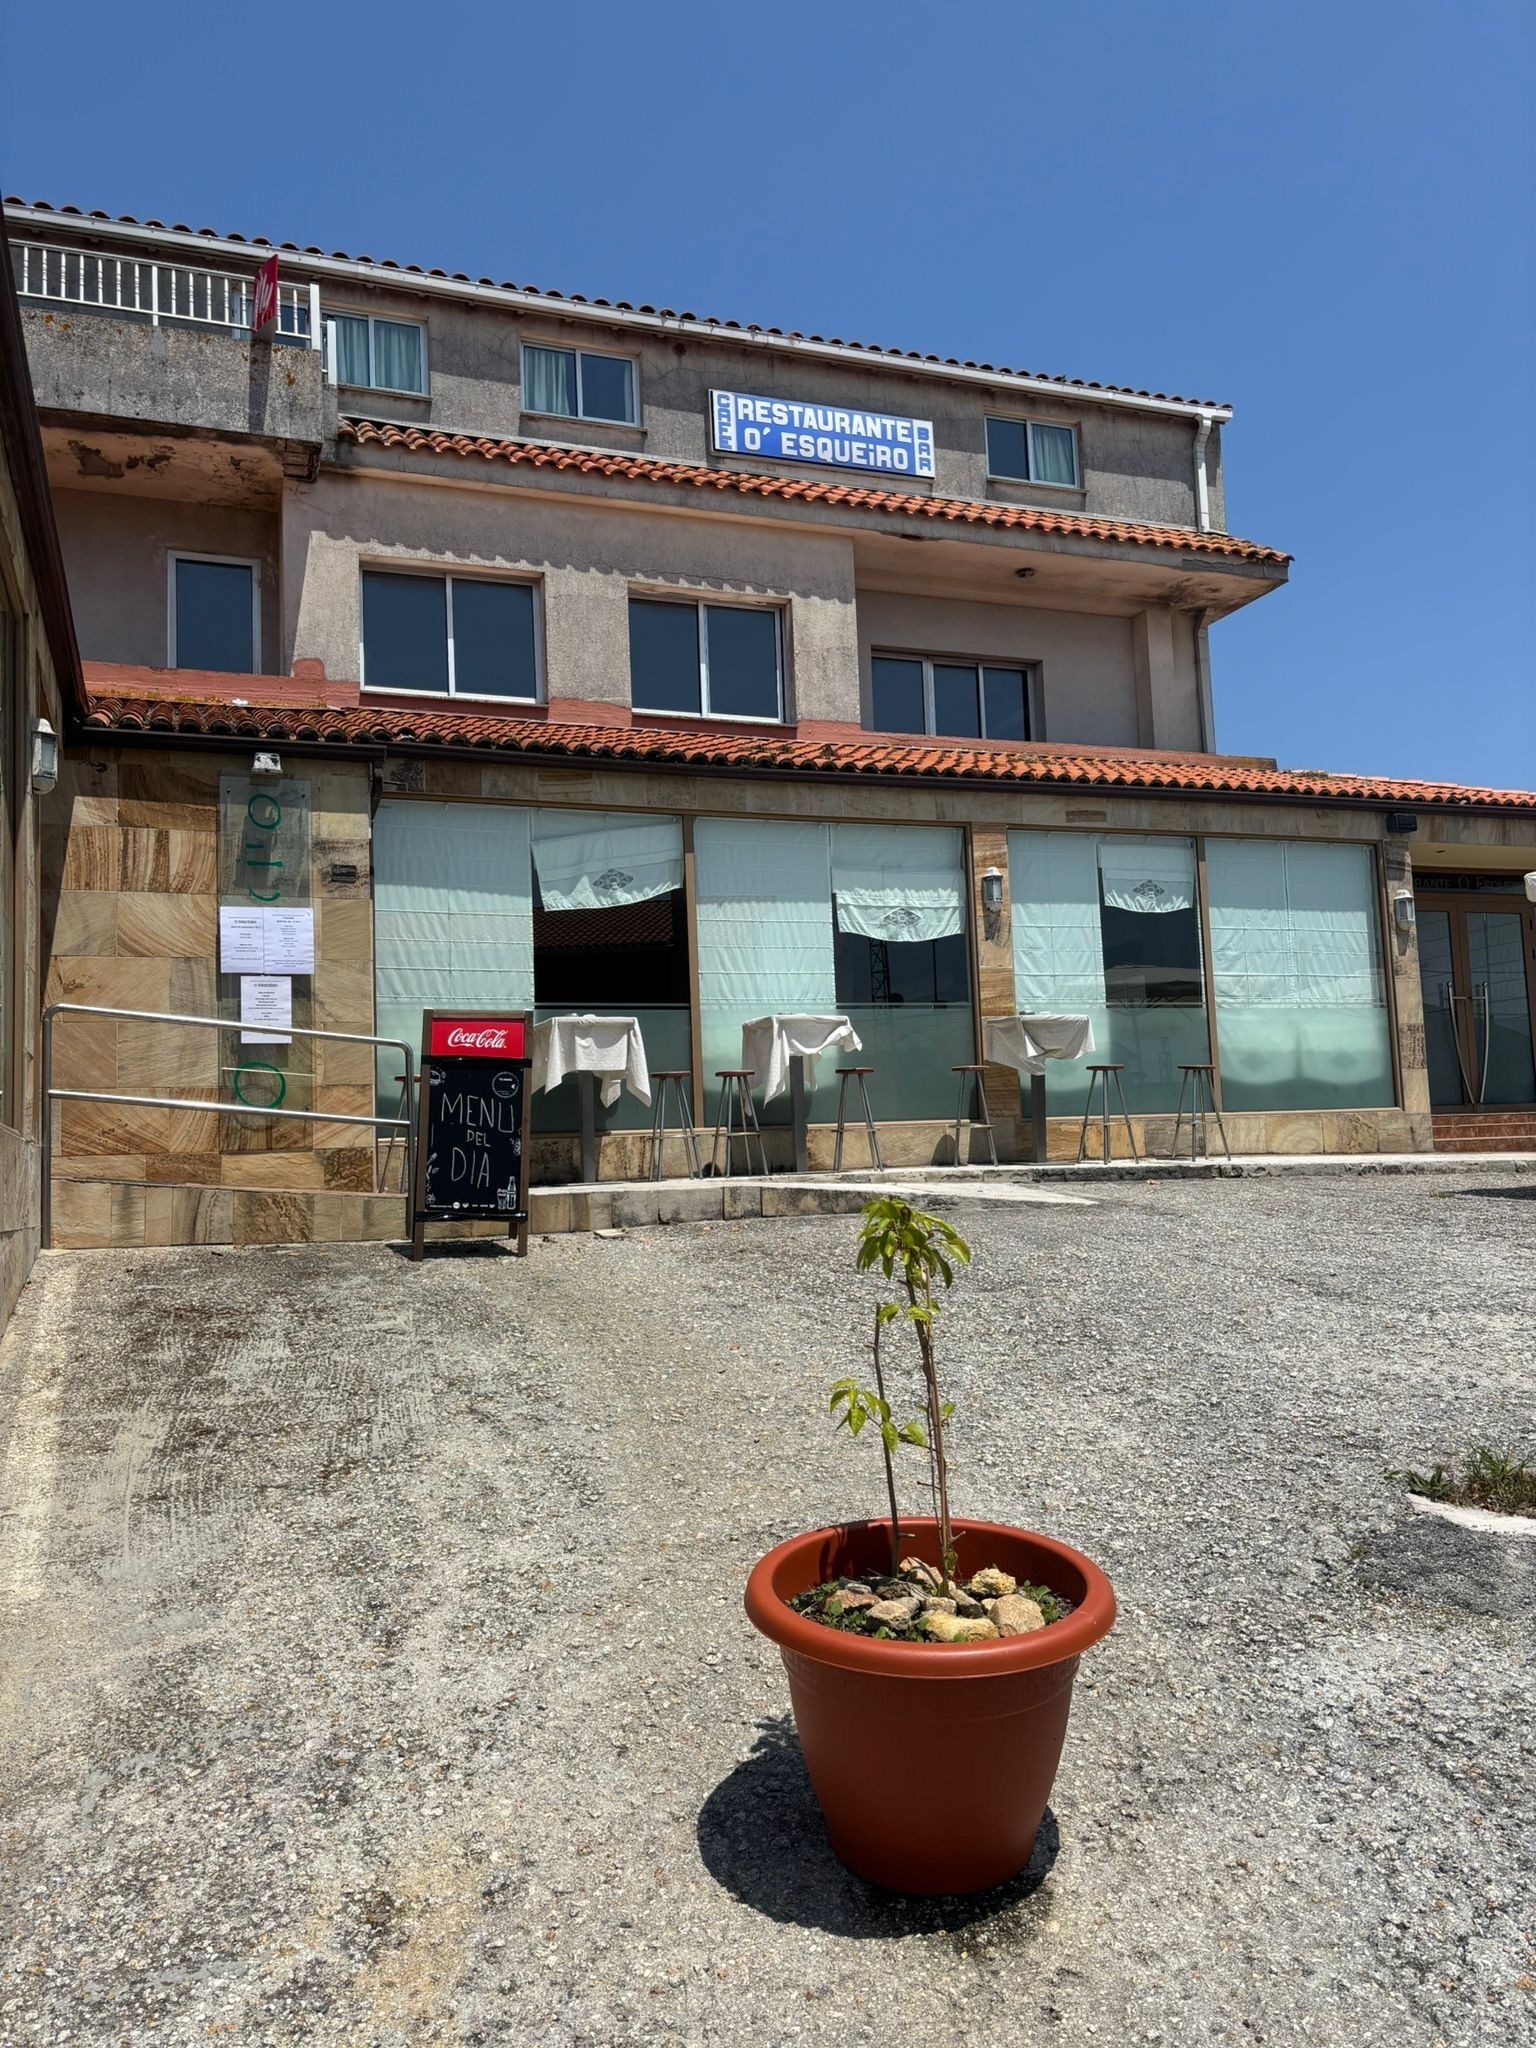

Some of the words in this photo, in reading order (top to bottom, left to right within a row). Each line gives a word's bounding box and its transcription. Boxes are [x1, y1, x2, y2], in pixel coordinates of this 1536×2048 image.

[717, 393, 733, 450] CAFE
[738, 398, 912, 444] RESTAURANTE
[917, 426, 931, 472] BAR
[441, 1093, 514, 1133] MENU
[466, 1129, 491, 1147] DEL
[451, 1147, 490, 1189] DIA
